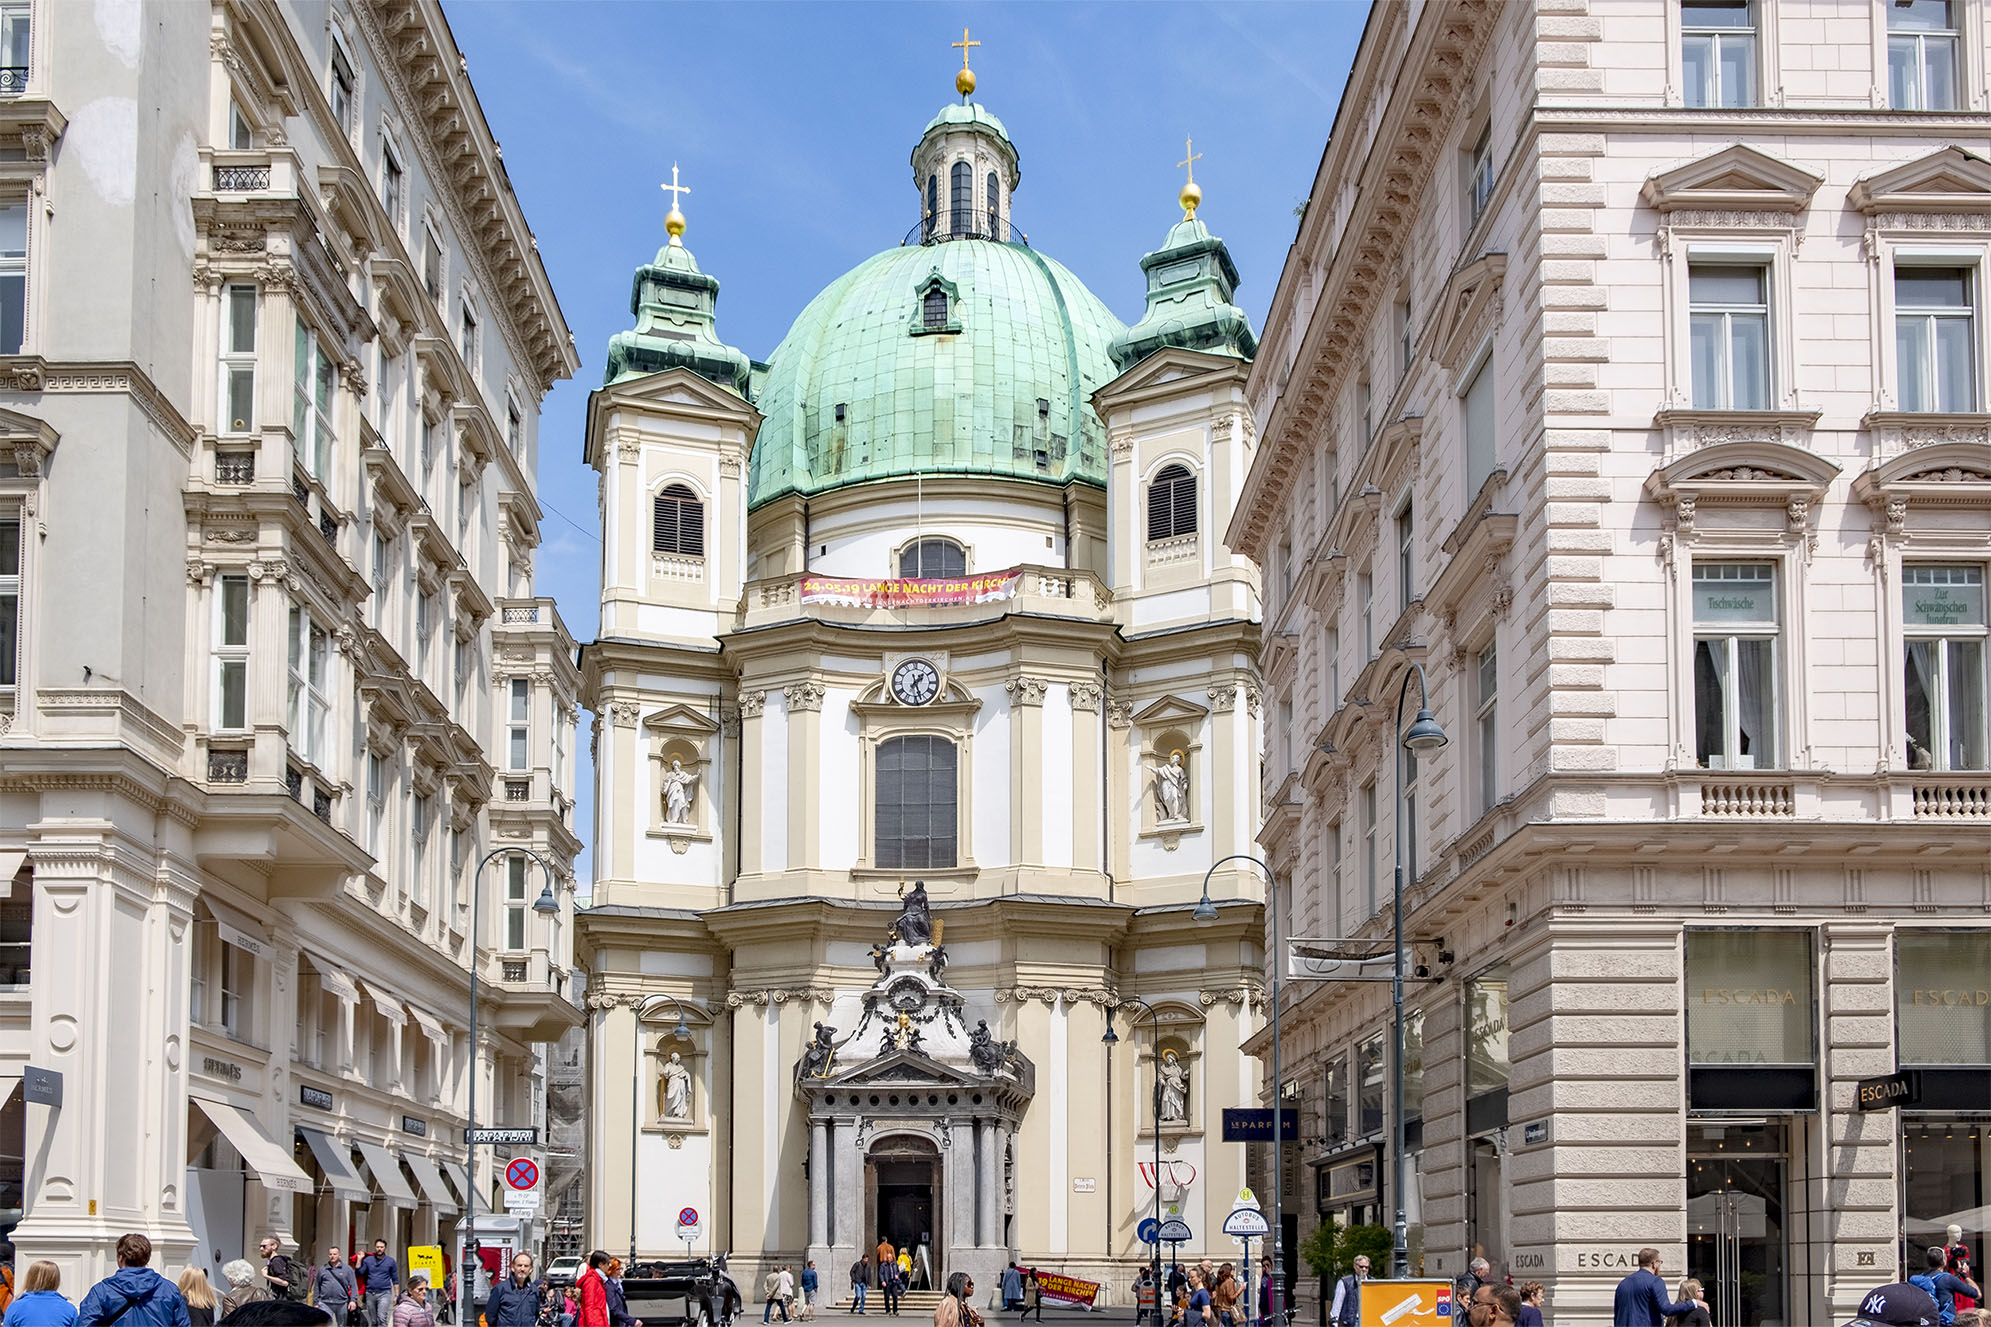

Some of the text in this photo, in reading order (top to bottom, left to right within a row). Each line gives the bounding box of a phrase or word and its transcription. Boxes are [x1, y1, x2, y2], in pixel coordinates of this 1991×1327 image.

[804, 577, 1010, 594] 24.05.19 LANGE NACHT DER KIRCH
[1934, 587, 1949, 599] Zur
[1707, 596, 1754, 609] Tischwäsche
[1703, 988, 1796, 1004] ESCADA
[1913, 989, 1991, 1007] ESCAD
[1861, 1080, 1909, 1102] ESCADA
[1516, 1254, 1545, 1269] ESCADA
[1578, 1253, 1640, 1267] ESCAD
[1047, 1283, 1062, 1292] DER
[1063, 1286, 1095, 1298] KIRCHEN
[1048, 1276, 1072, 1287] LANGE
[1073, 1281, 1097, 1291] NACHT
